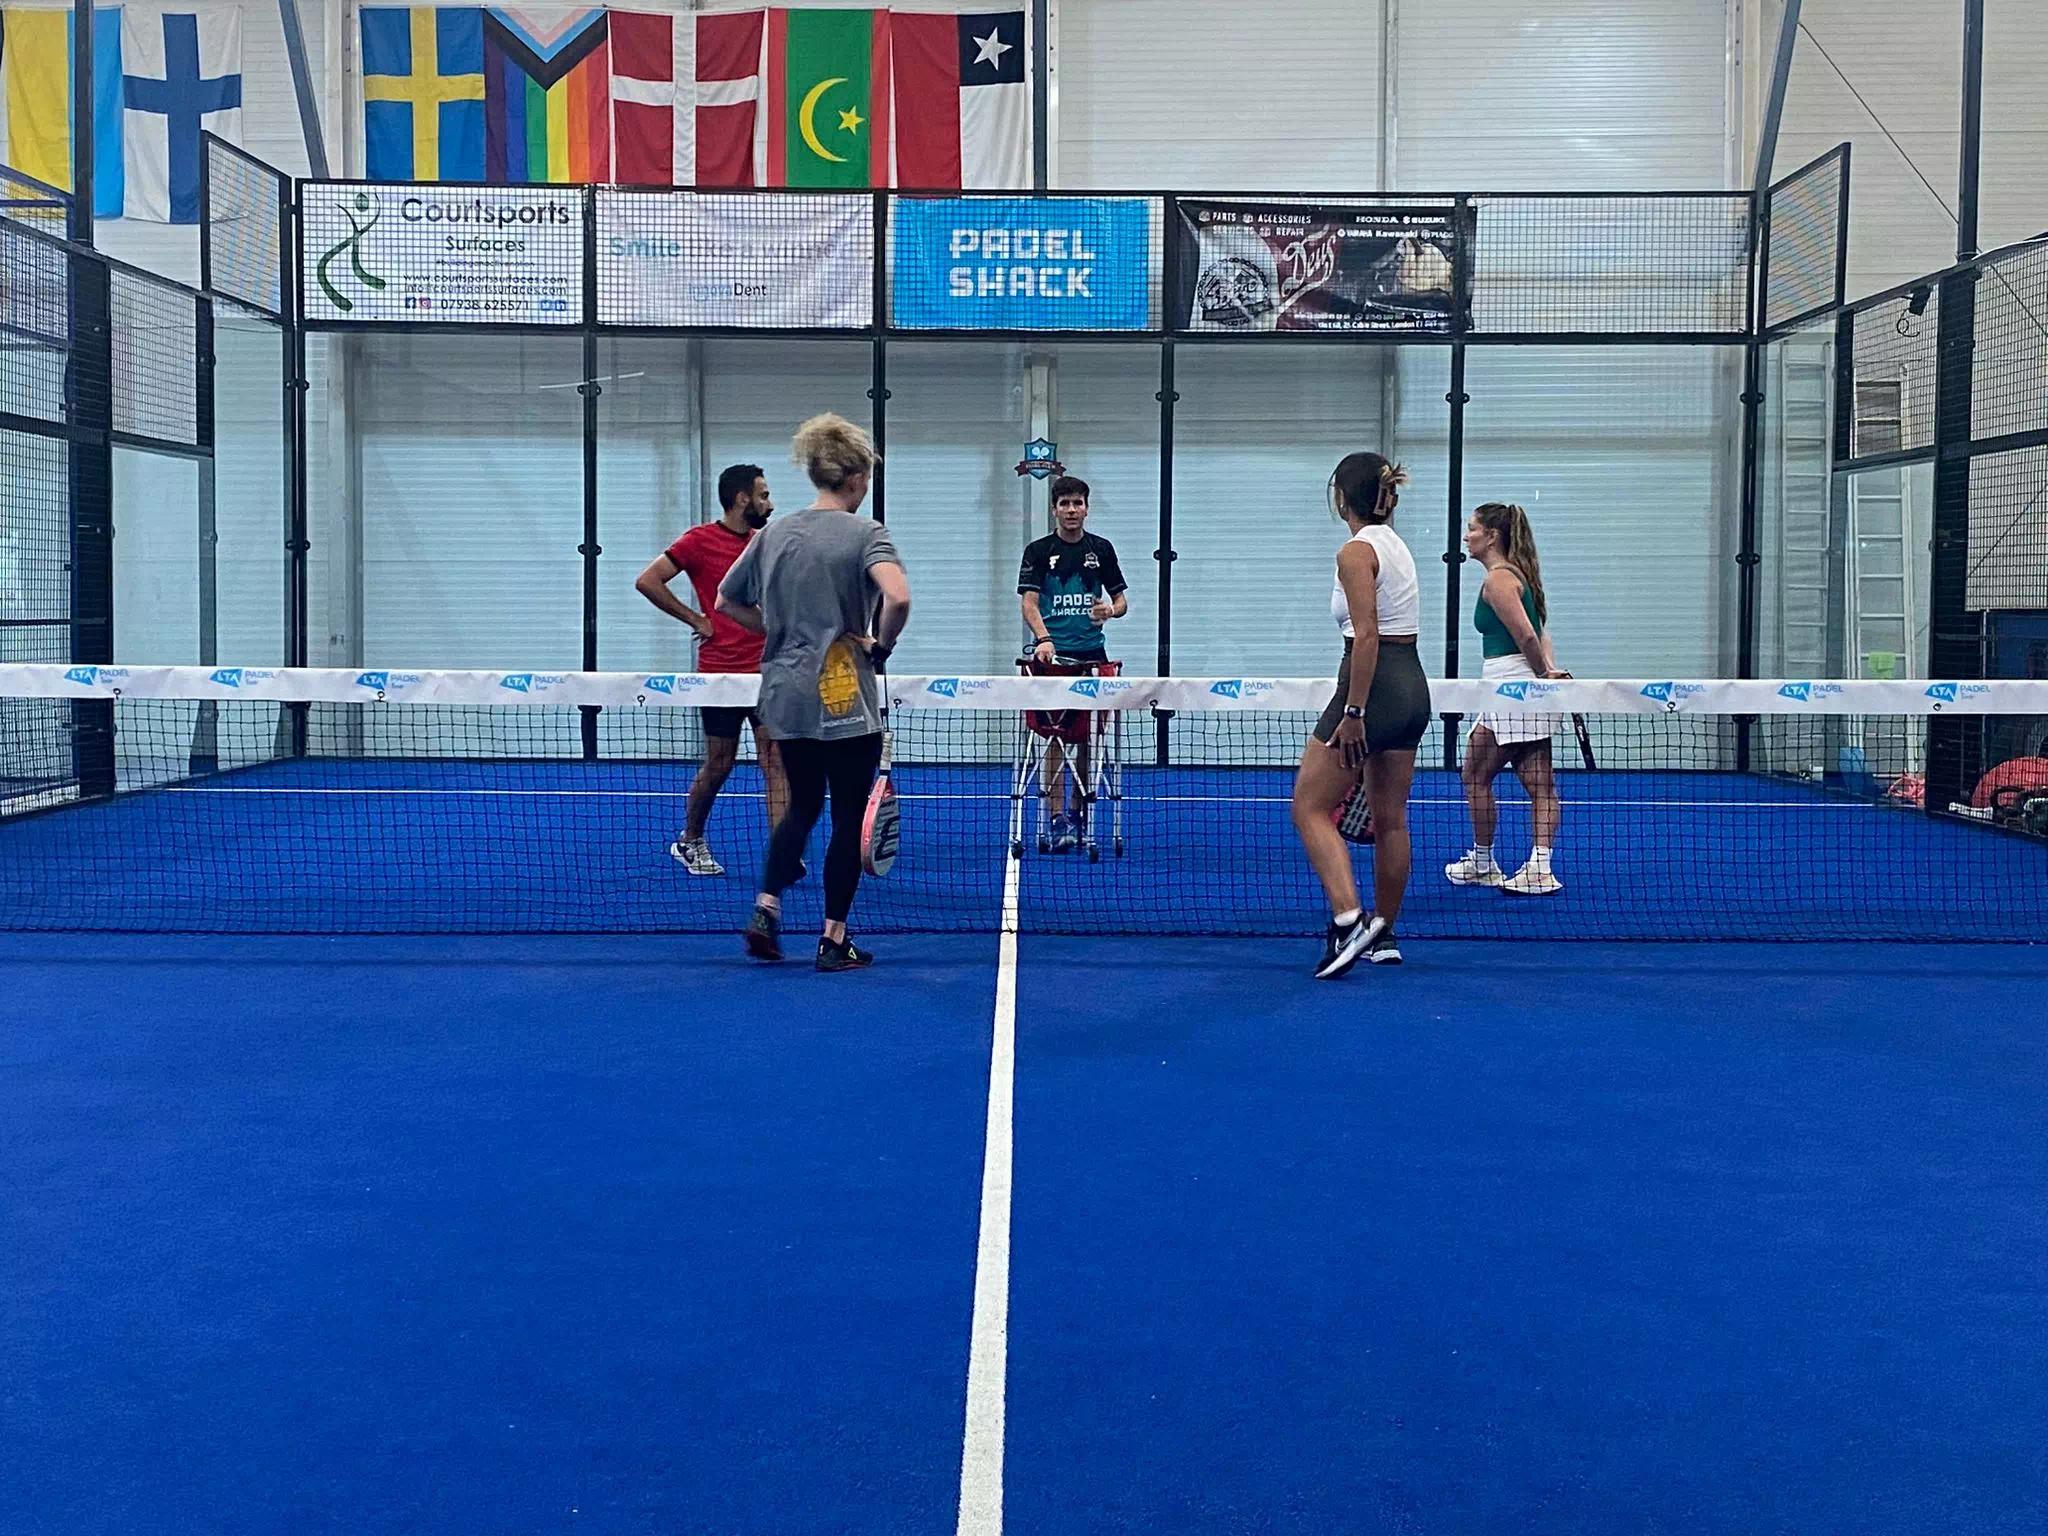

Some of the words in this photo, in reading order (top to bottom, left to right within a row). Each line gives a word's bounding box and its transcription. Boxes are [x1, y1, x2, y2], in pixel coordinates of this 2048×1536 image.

[401, 198, 570, 229] Courtsports
[1212, 212, 1237, 221] PARTS
[1257, 214, 1311, 224] ACCESSORIES
[1276, 227, 1304, 236] REPAIR
[445, 236, 525, 252] Surfaces
[950, 229, 1095, 259] PADEL
[403, 273, 568, 285] www.courtsportssurfaces.com
[949, 267, 1095, 297] SHACK
[441, 300, 480, 310] 07938
[1053, 594, 1093, 606] PADE
[99, 669, 129, 677] PADEL
[391, 674, 422, 683] PADEL
[535, 675, 565, 684] PADEL
[678, 677, 706, 685] PADEL
[961, 680, 990, 689] PADEL
[1103, 681, 1132, 689] PADEL
[1244, 681, 1274, 690] PADEL
[1529, 683, 1559, 691] PADEL
[1674, 684, 1705, 692] PADEL
[1813, 684, 1843, 692] PADEL
[1960, 684, 1991, 692] PADEL
